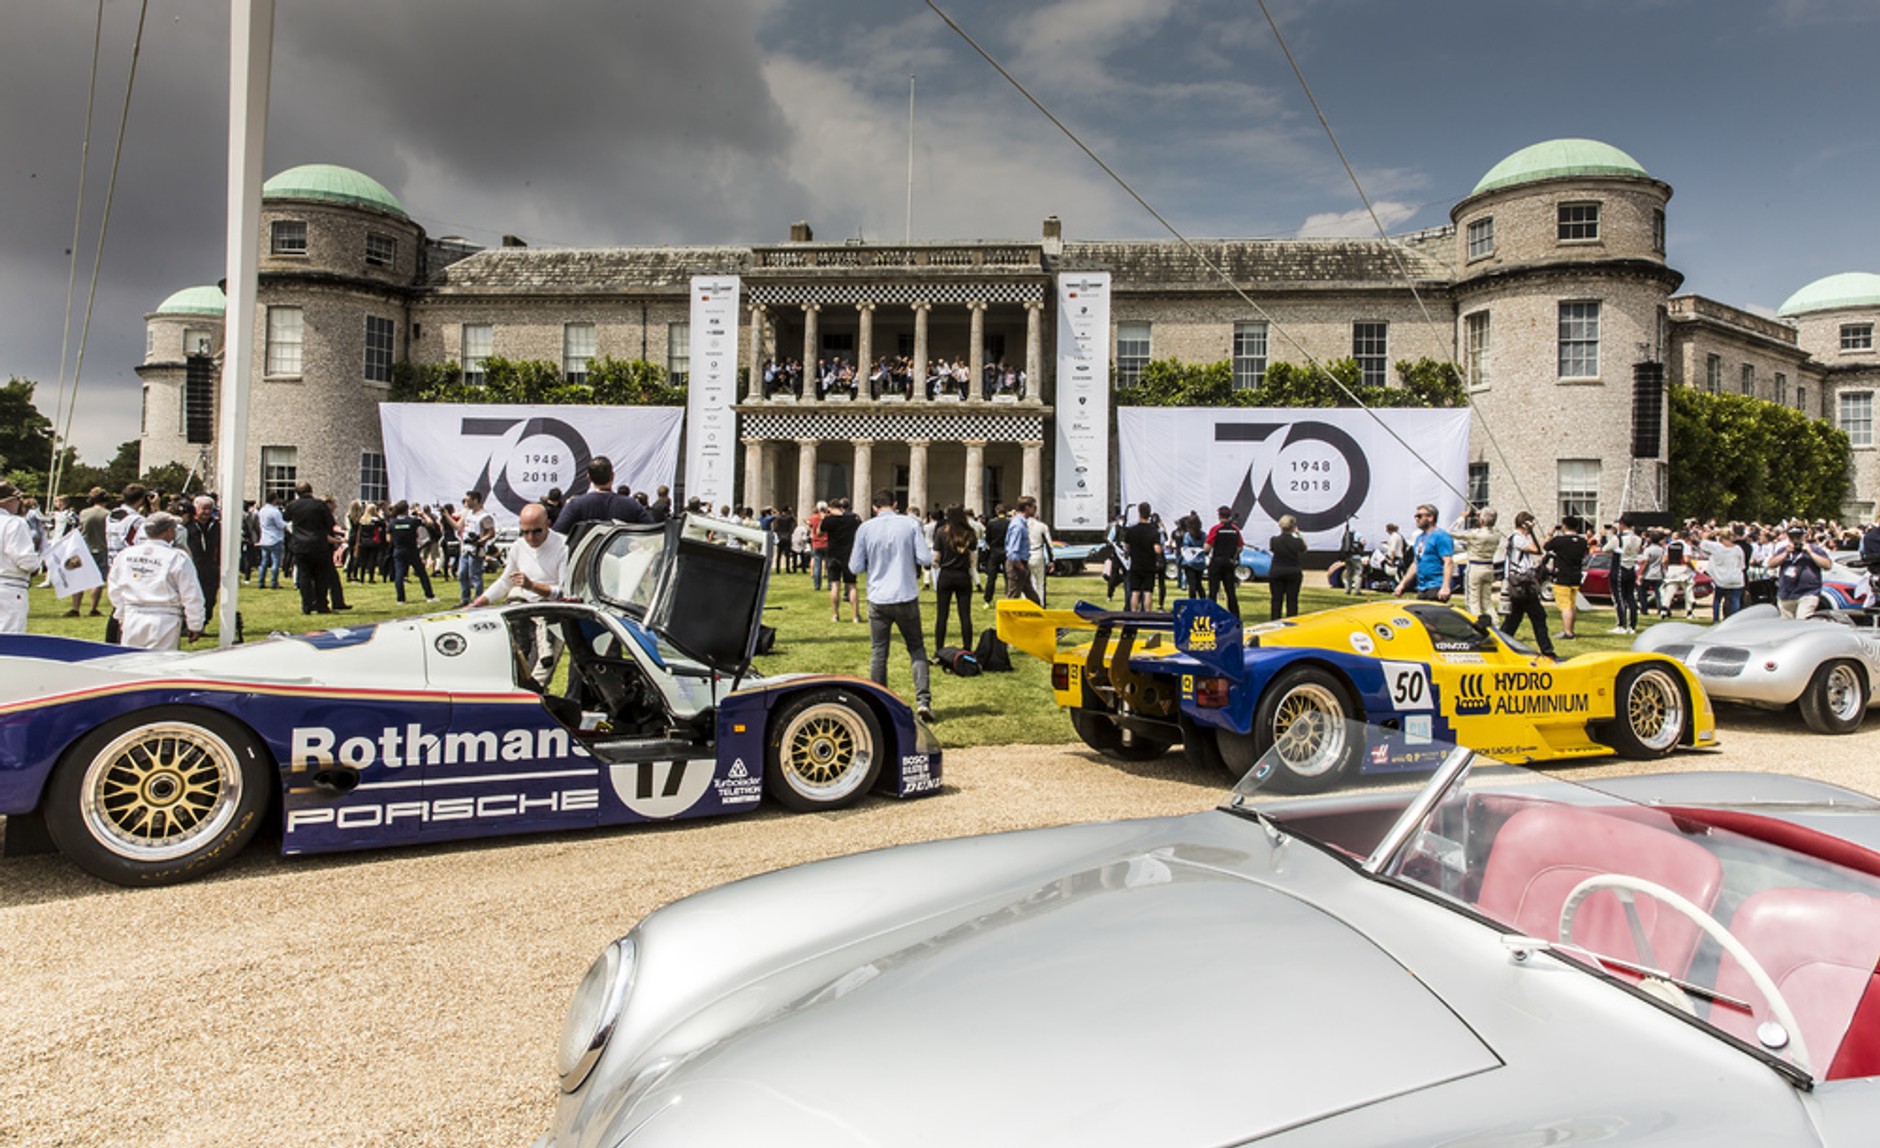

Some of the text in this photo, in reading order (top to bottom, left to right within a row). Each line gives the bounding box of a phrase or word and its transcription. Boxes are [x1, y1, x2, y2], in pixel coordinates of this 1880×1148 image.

[461, 417, 592, 519] 70
[525, 454, 559, 465] 1948
[1291, 460, 1331, 472] 1948
[522, 472, 558, 483] 2018
[1215, 420, 1370, 532] 70
[1290, 480, 1331, 492] 2018
[1435, 642, 1470, 650] KENWOOD
[1394, 671, 1423, 703] 50
[1494, 672, 1553, 691] HYDRO
[1494, 693, 1589, 715] ALUMINIUM
[902, 755, 928, 766] BOSCH
[903, 777, 942, 794] DUNL
[287, 788, 599, 833] PORSCHE
